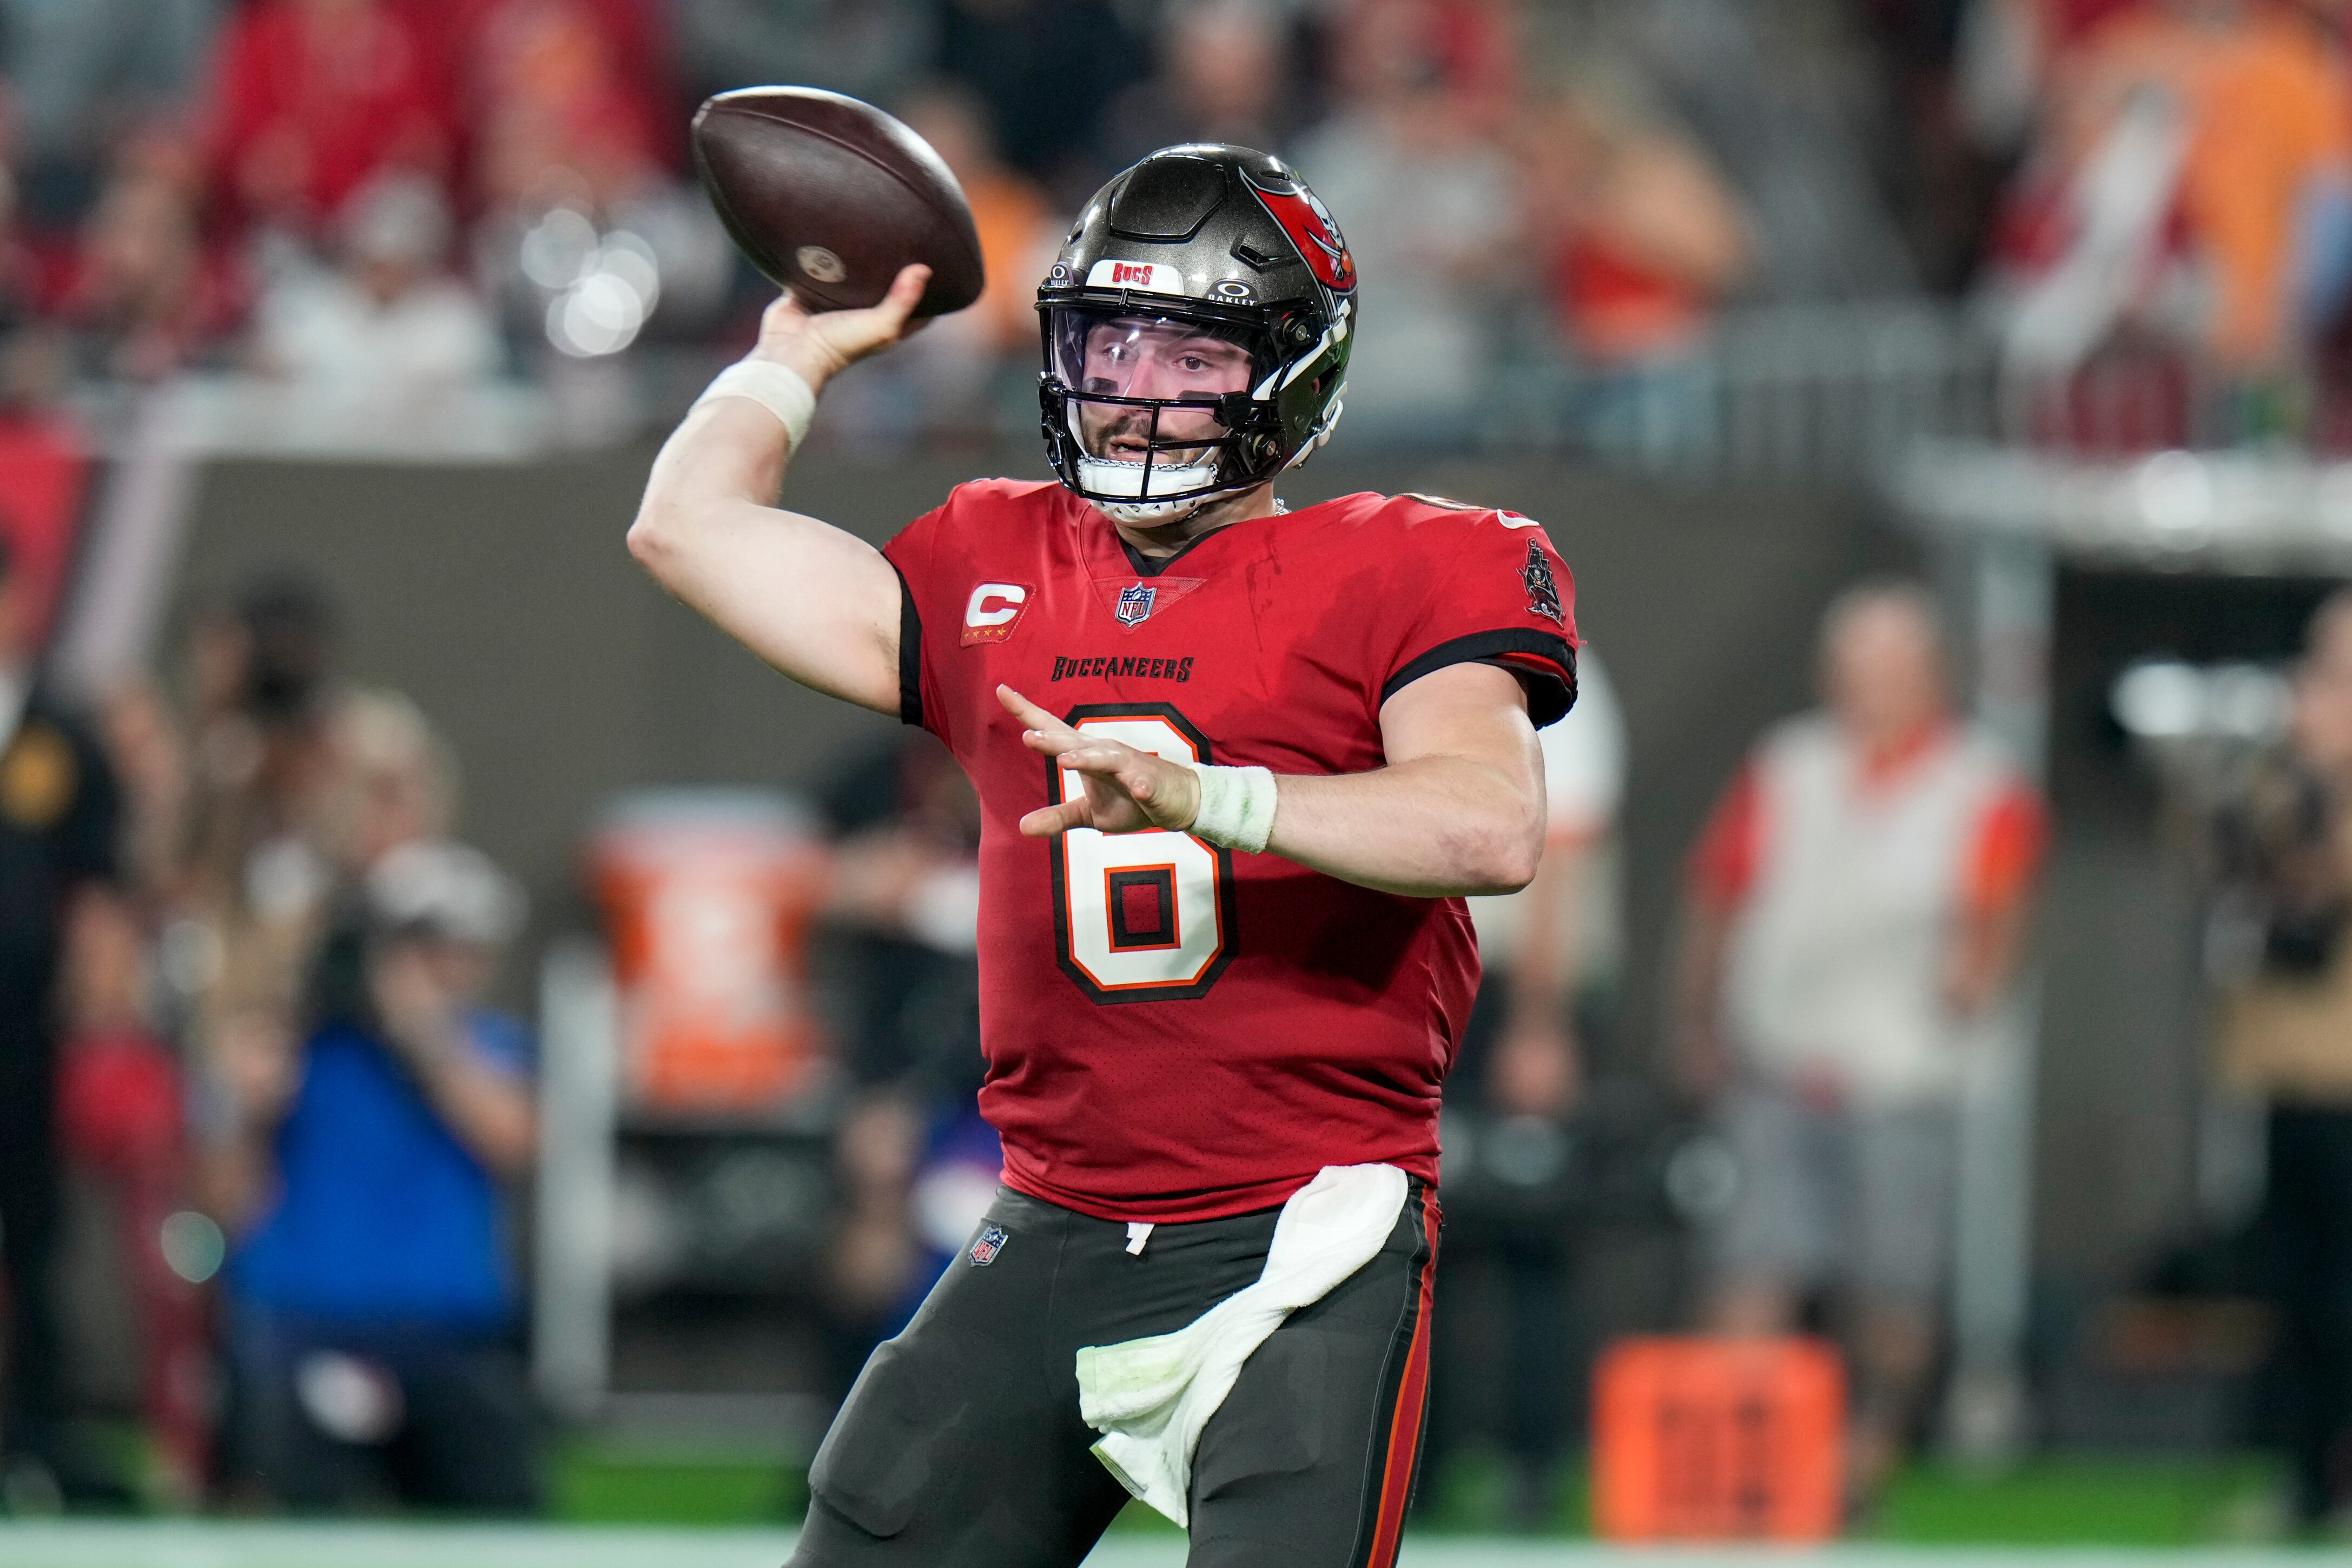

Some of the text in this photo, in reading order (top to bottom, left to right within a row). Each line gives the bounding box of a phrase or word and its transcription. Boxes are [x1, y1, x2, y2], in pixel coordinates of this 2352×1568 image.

[1208, 294, 1256, 306] OAKLEY
[966, 584, 1026, 627] C
[1121, 602, 1145, 618] NFL
[1051, 656, 1194, 684] BUCCANEERS
[1045, 702, 1240, 1005] 6
[974, 1241, 993, 1260] NFL
